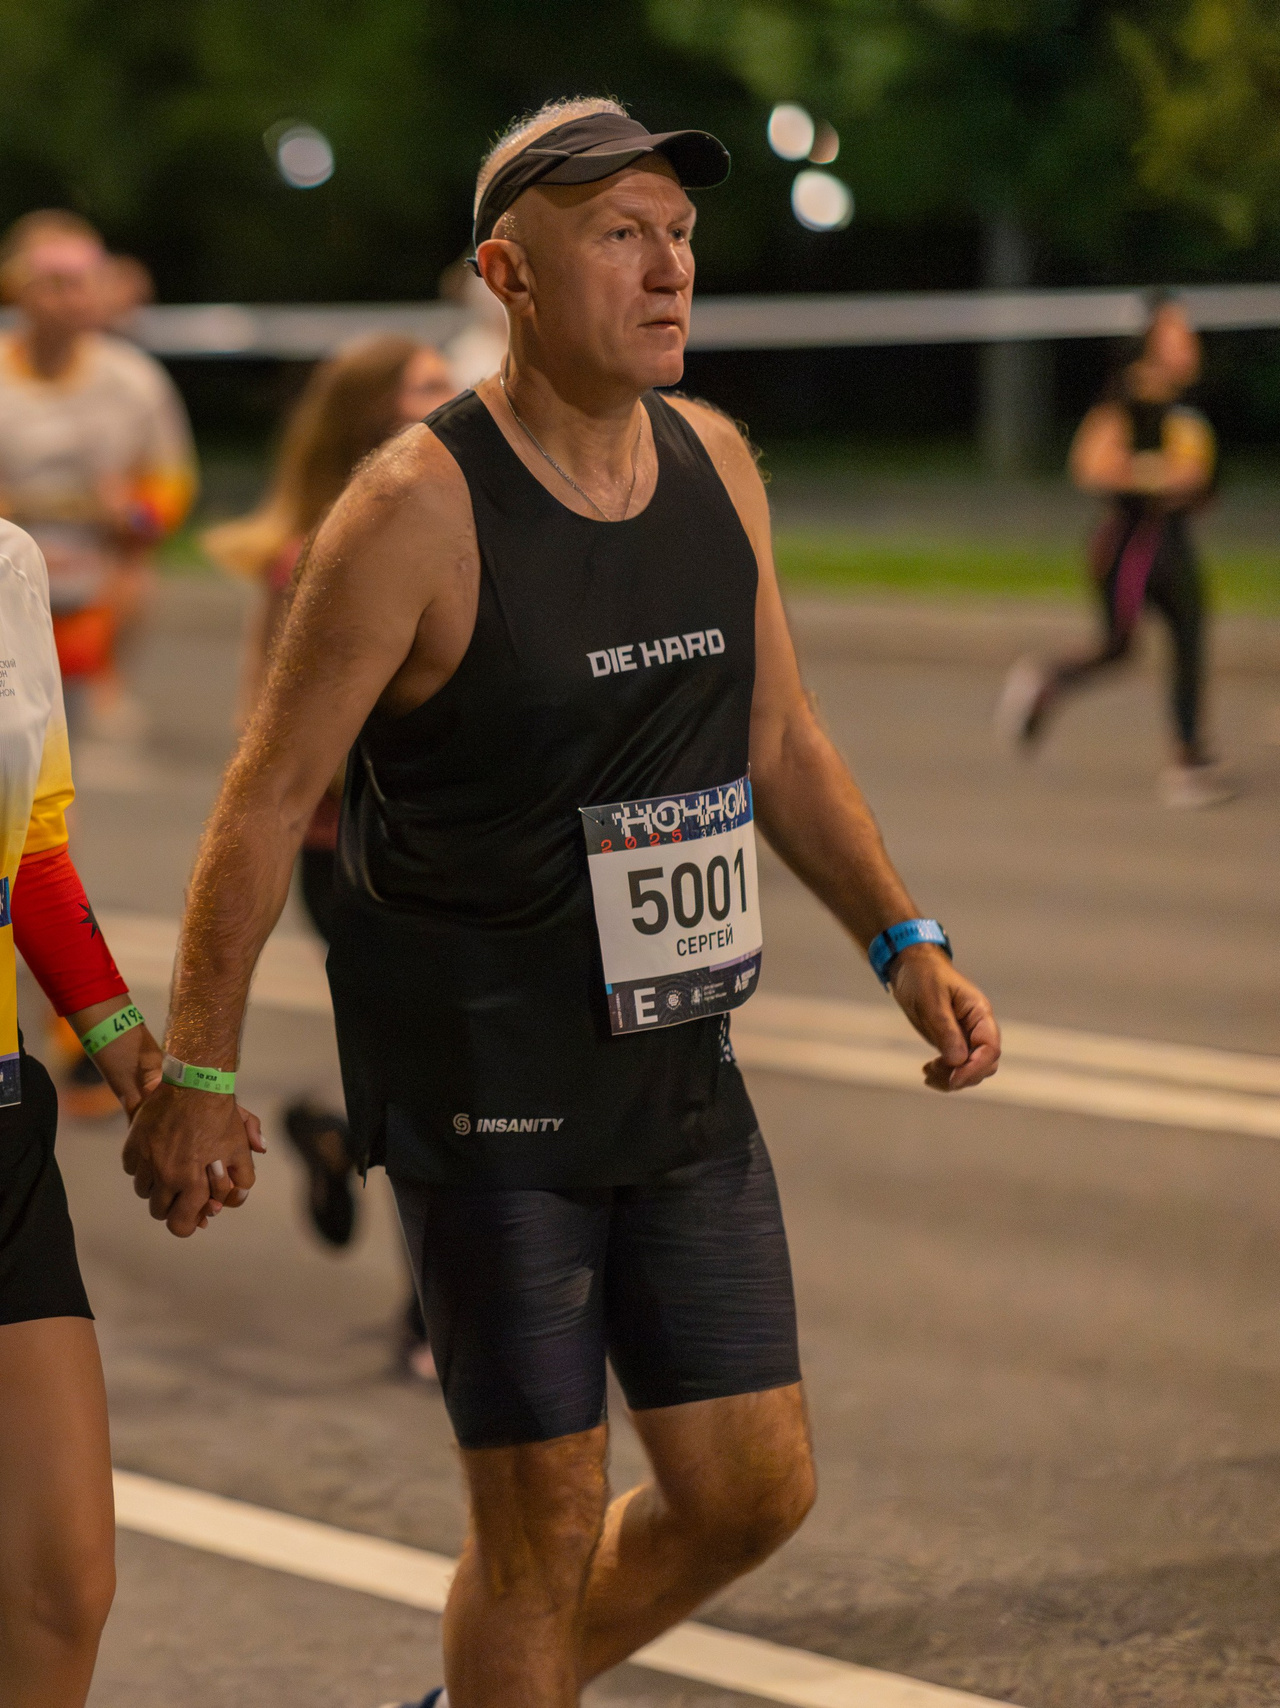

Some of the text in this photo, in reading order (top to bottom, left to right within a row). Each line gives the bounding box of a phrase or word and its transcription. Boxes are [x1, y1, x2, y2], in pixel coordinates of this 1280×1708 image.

[586, 628, 726, 678] DIE HARD
[600, 829, 683, 854] 2025
[627, 847, 747, 936] 5001
[676, 923, 734, 957] СЕРГЕЙ
[633, 987, 659, 1025] E
[476, 1118, 564, 1133] INSANITY
